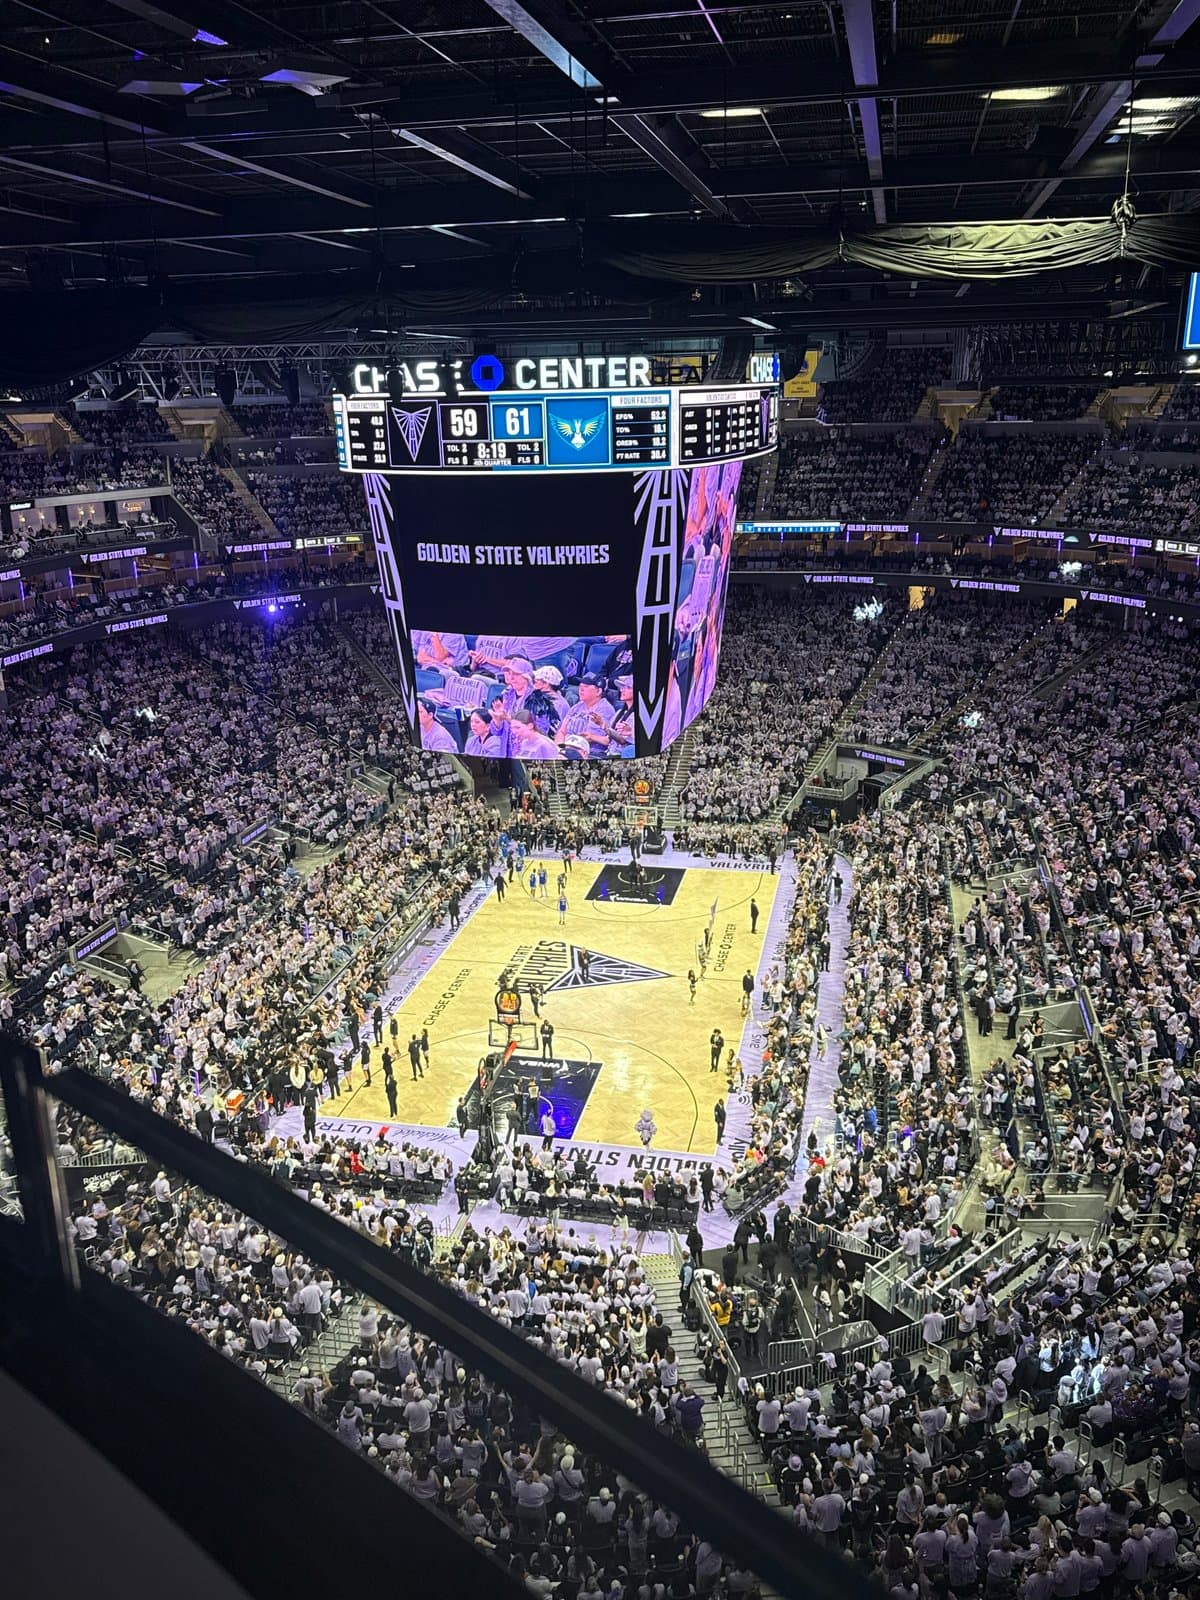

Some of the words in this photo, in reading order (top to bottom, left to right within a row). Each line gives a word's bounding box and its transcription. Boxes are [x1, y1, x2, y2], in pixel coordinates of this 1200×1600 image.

[354, 361, 464, 393] CHAS
[515, 357, 651, 389] CENTER
[450, 408, 478, 436] 59
[506, 408, 530, 436] 61
[478, 442, 506, 458] 8:19
[417, 543, 470, 564] GOLDEN
[474, 546, 522, 565] STATE
[527, 544, 610, 565] VALKYRIES
[0, 569, 20, 582] ALKYRIES
[714, 950, 730, 972] CHASE
[724, 923, 737, 945] CENTER
[423, 1000, 451, 1026] CHASE
[448, 968, 472, 992] CENTER
